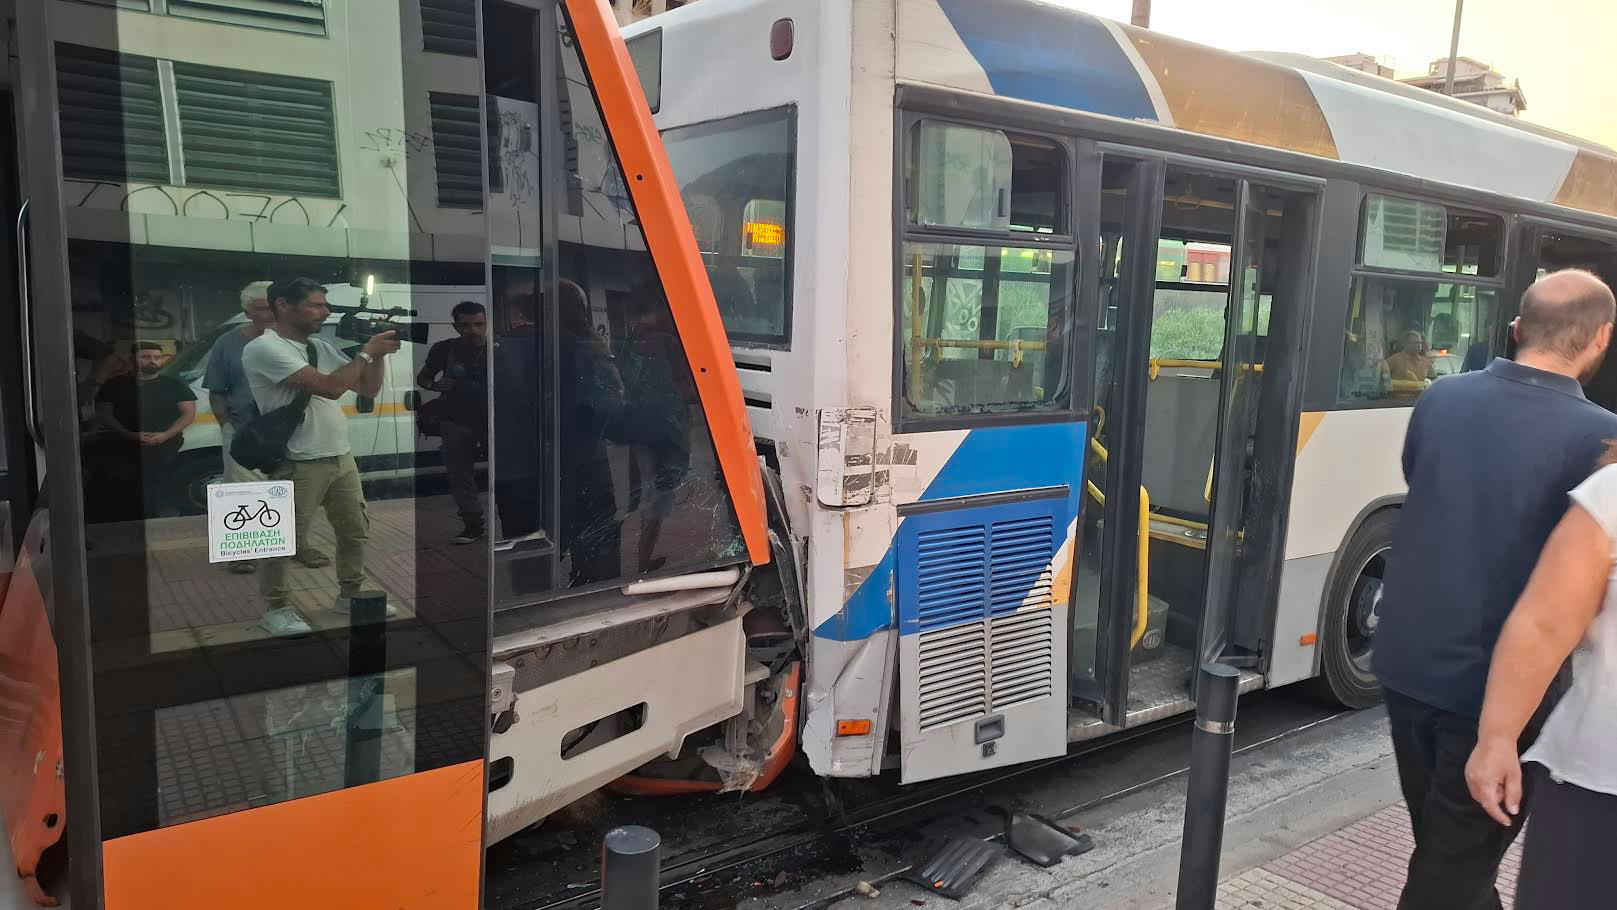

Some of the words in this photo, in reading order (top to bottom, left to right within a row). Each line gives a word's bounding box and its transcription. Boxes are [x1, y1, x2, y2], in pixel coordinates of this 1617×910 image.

[225, 529, 281, 541] ΕΠΙΒΙΒΑΣΗ
[220, 537, 286, 550] ΠΟΔΗΛΑΤΩΝ
[254, 546, 286, 554] Entrance
